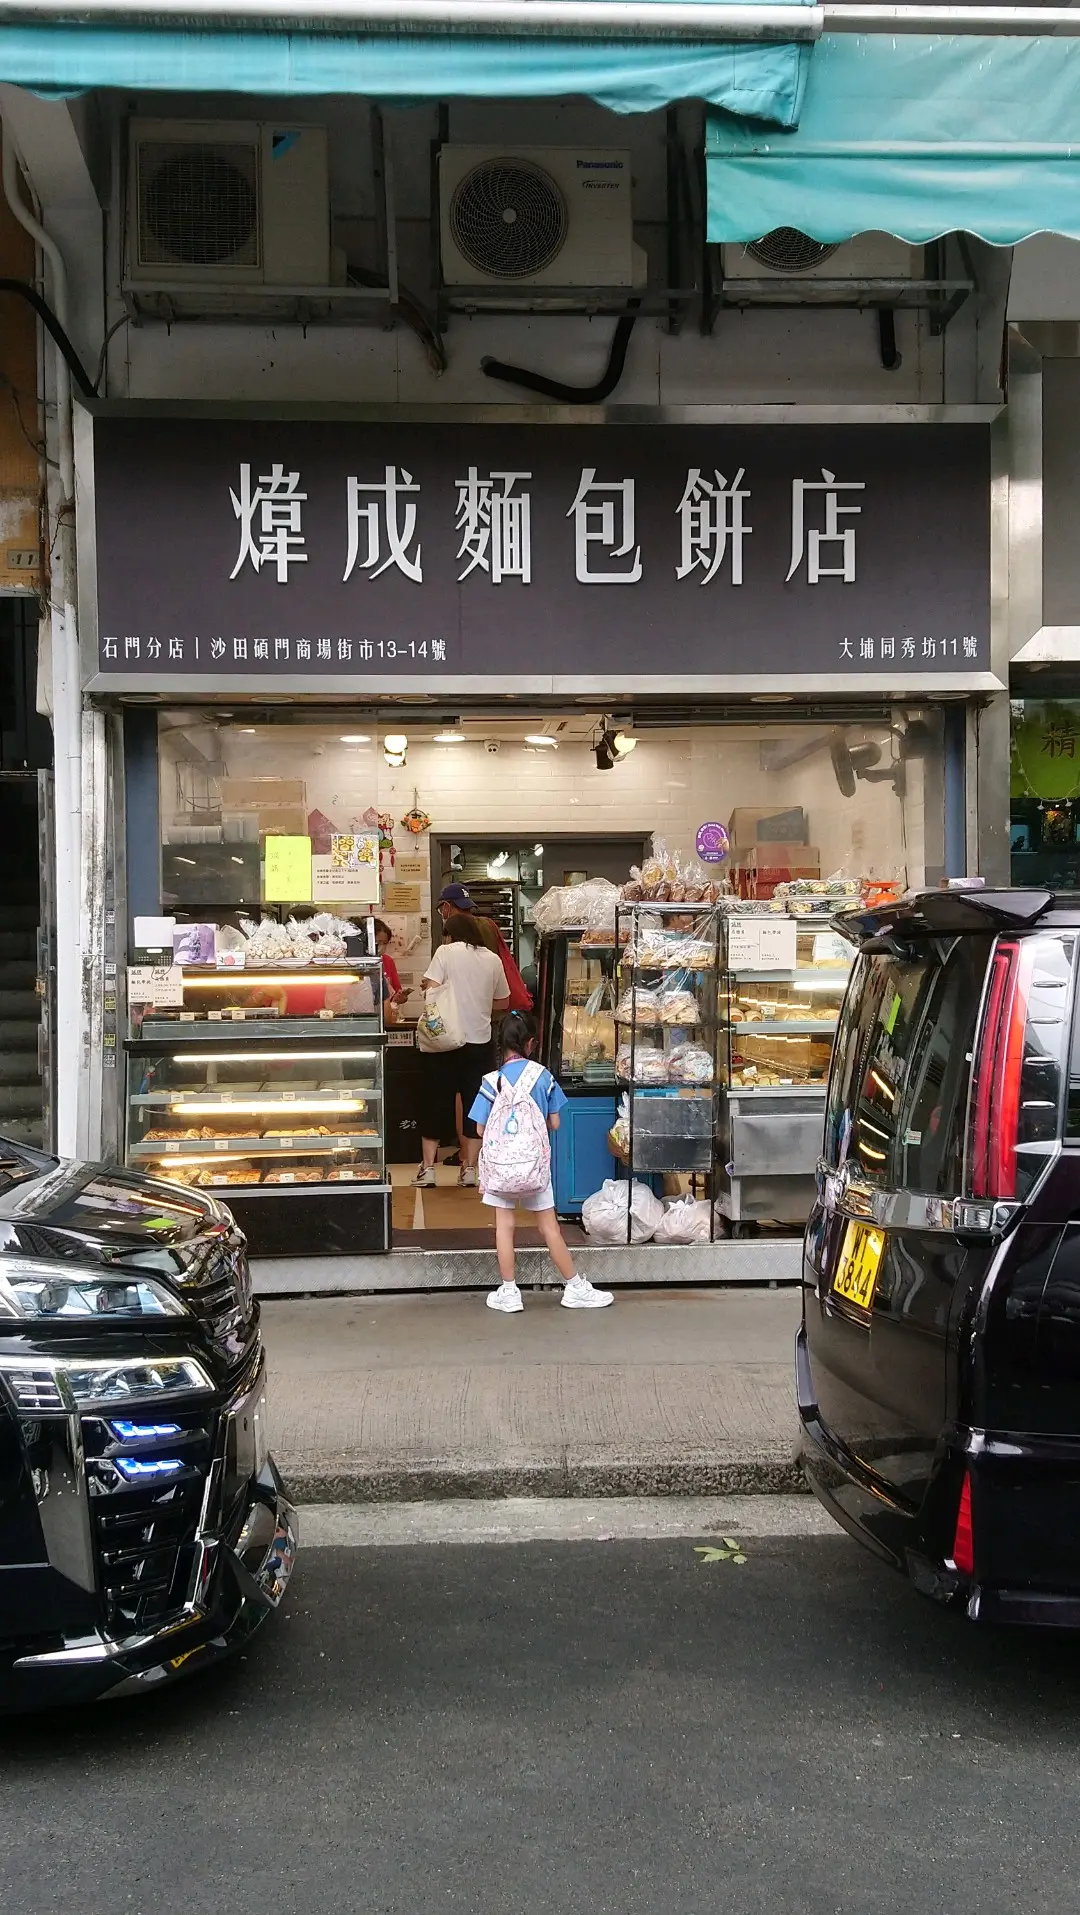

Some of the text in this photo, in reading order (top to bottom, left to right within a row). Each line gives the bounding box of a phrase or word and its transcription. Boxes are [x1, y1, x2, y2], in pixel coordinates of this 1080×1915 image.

[576, 160, 624, 168] Panasonic
[230, 463, 865, 584] 煒成麵包餅店
[838, 636, 979, 661] 大埔同秀坊11號
